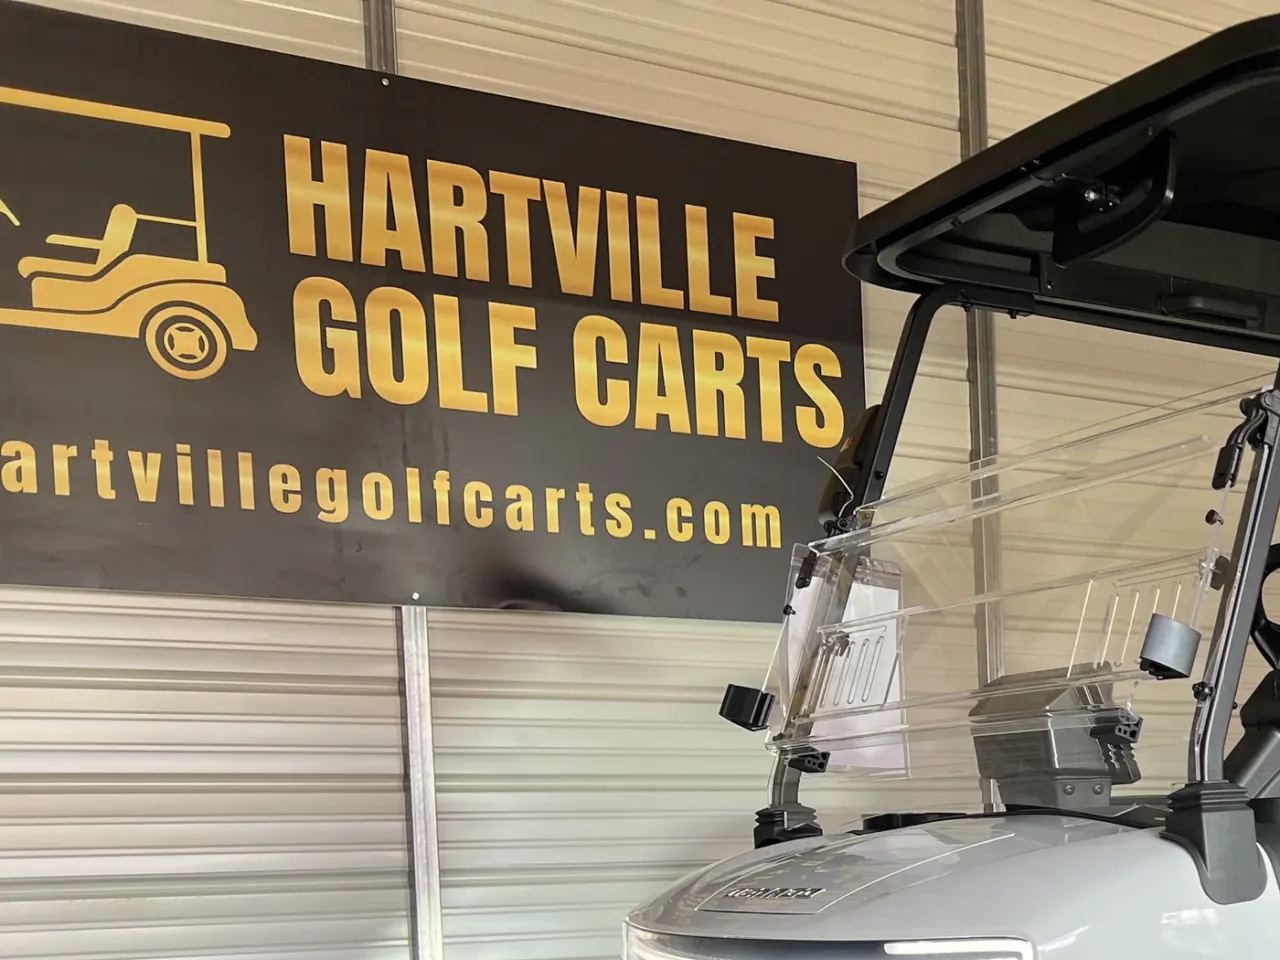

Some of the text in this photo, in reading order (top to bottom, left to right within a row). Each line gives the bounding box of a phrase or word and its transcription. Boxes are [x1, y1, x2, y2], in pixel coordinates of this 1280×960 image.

[283, 133, 780, 323] HARTVILLE
[292, 276, 845, 449] GOLF CARTS
[0, 438, 783, 549] artvillegolfcarts.com
